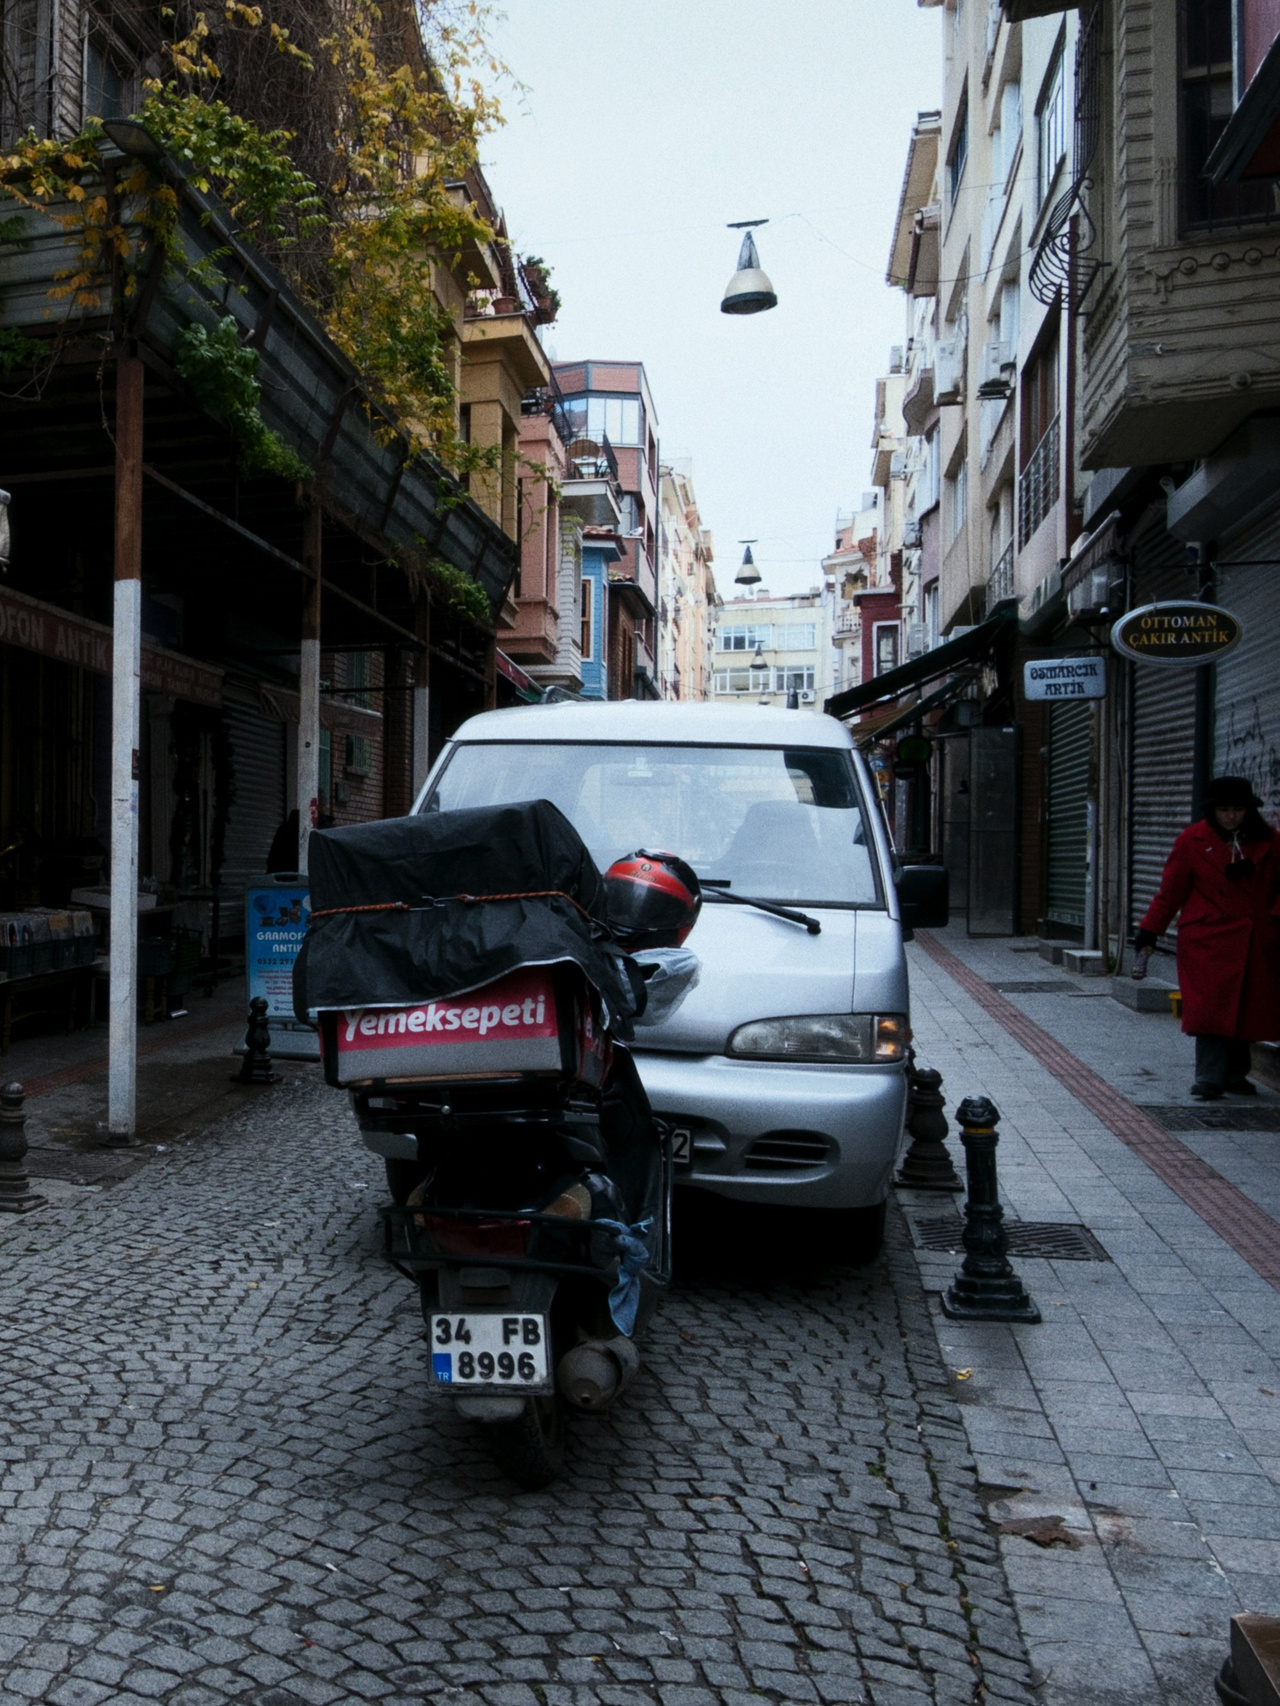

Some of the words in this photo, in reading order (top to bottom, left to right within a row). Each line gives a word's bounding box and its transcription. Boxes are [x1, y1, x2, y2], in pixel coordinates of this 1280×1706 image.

[1140, 614, 1218, 630] OTTOMAN
[54, 624, 111, 669] ANTİK
[1128, 631, 1178, 649] ÇAKIR
[1179, 626, 1230, 646] ANTİK
[255, 930, 306, 941] GRAMOF
[343, 994, 546, 1043] Yemeksepeti
[435, 1317, 472, 1346] 34
[502, 1317, 541, 1346] FB
[437, 1371, 450, 1381] TR
[458, 1351, 536, 1380] 8996
